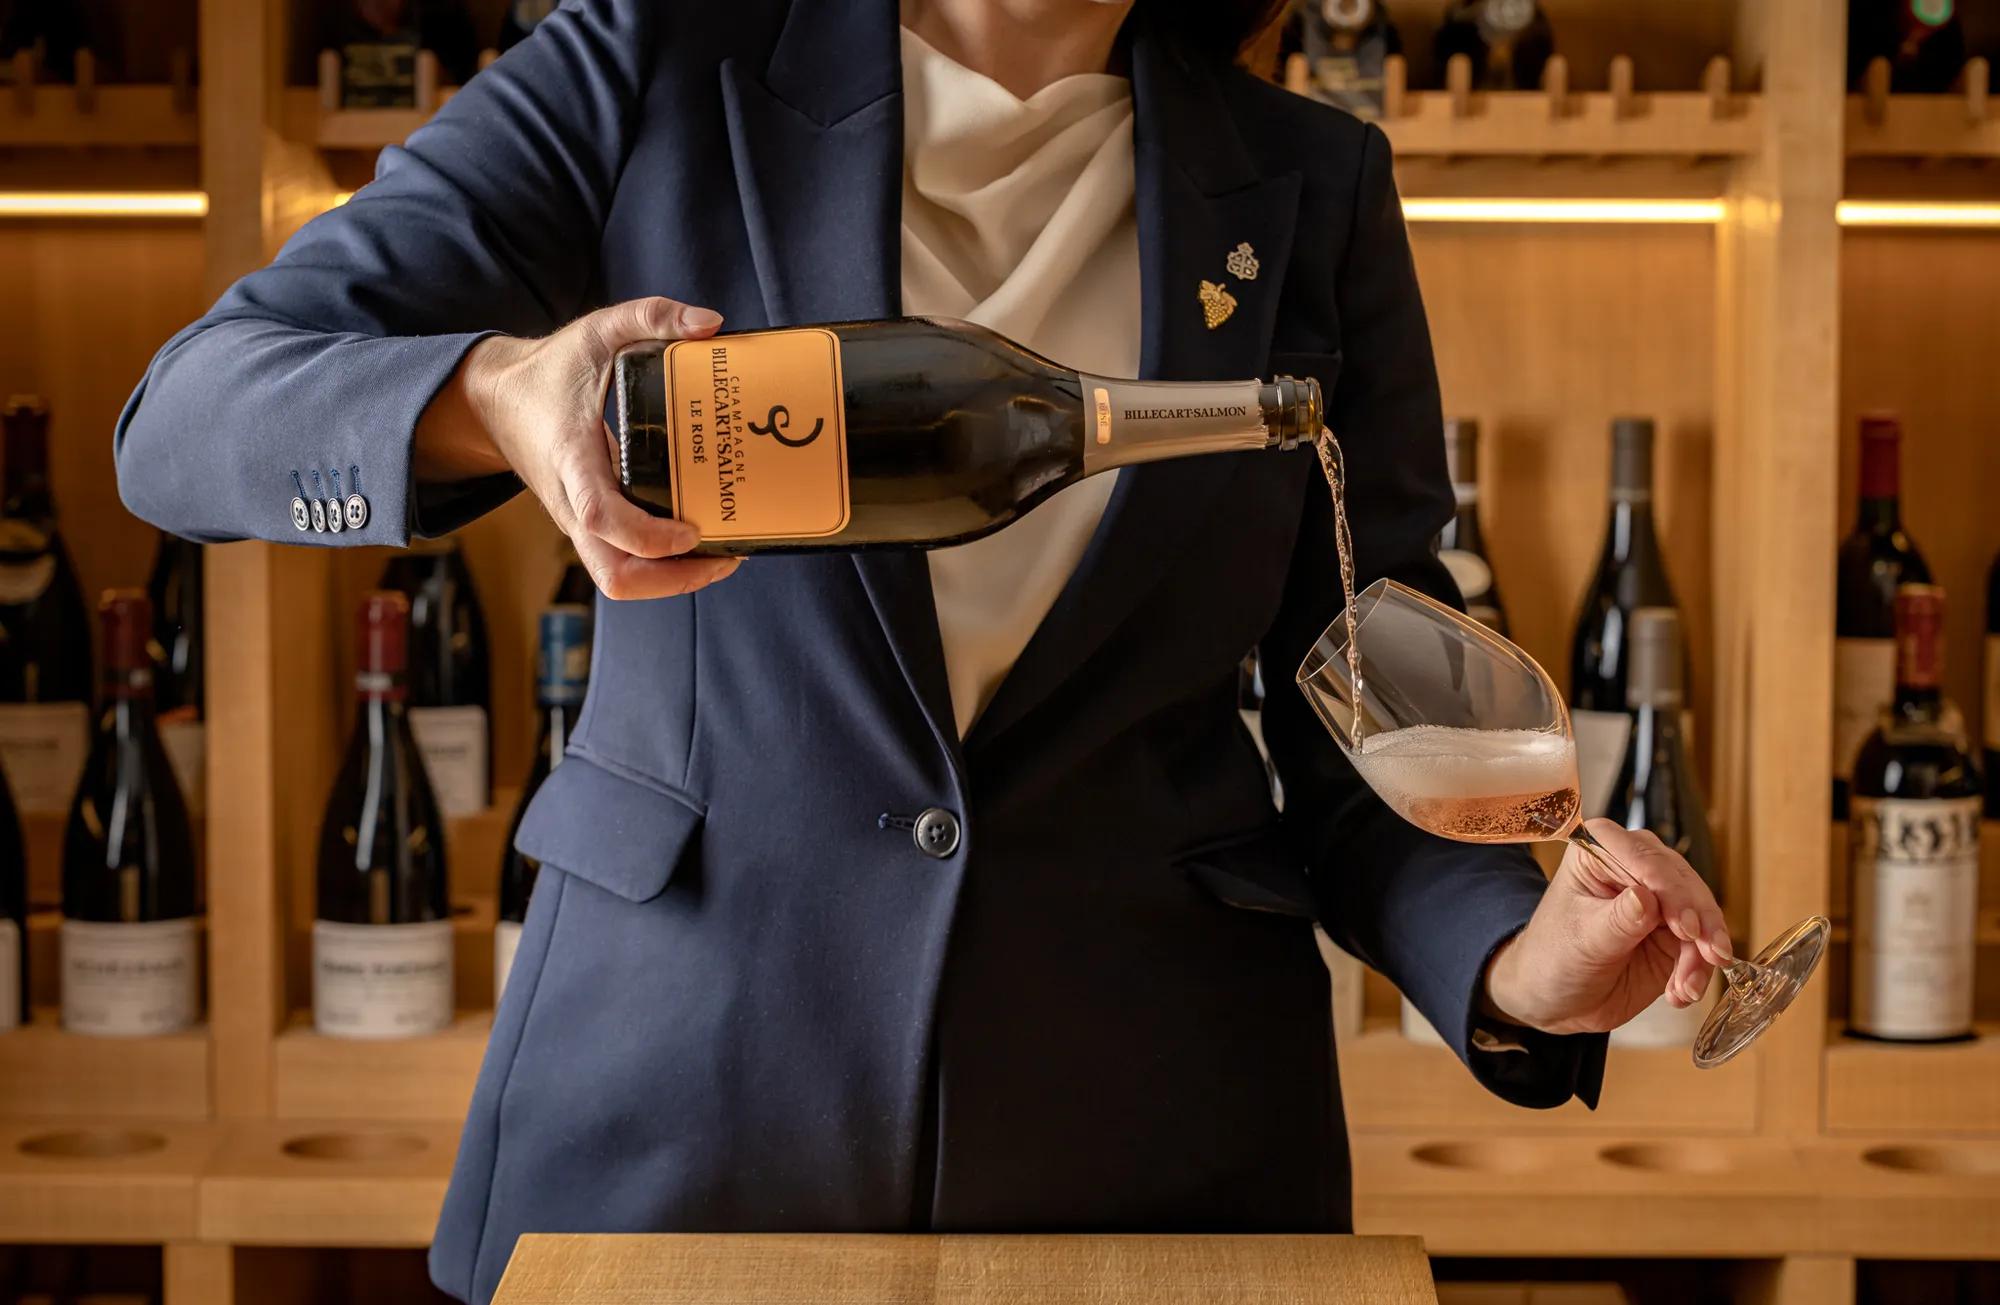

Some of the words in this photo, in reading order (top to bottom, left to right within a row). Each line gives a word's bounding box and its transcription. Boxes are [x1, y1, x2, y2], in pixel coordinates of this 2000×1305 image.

[690, 400, 702, 417] LE
[1124, 406, 1247, 420] BILLECART-SALMON
[692, 423, 708, 464] ROSÉ
[712, 347, 737, 522] BILLECART-SALMON
[730, 376, 745, 483] CHAMPAGNE
